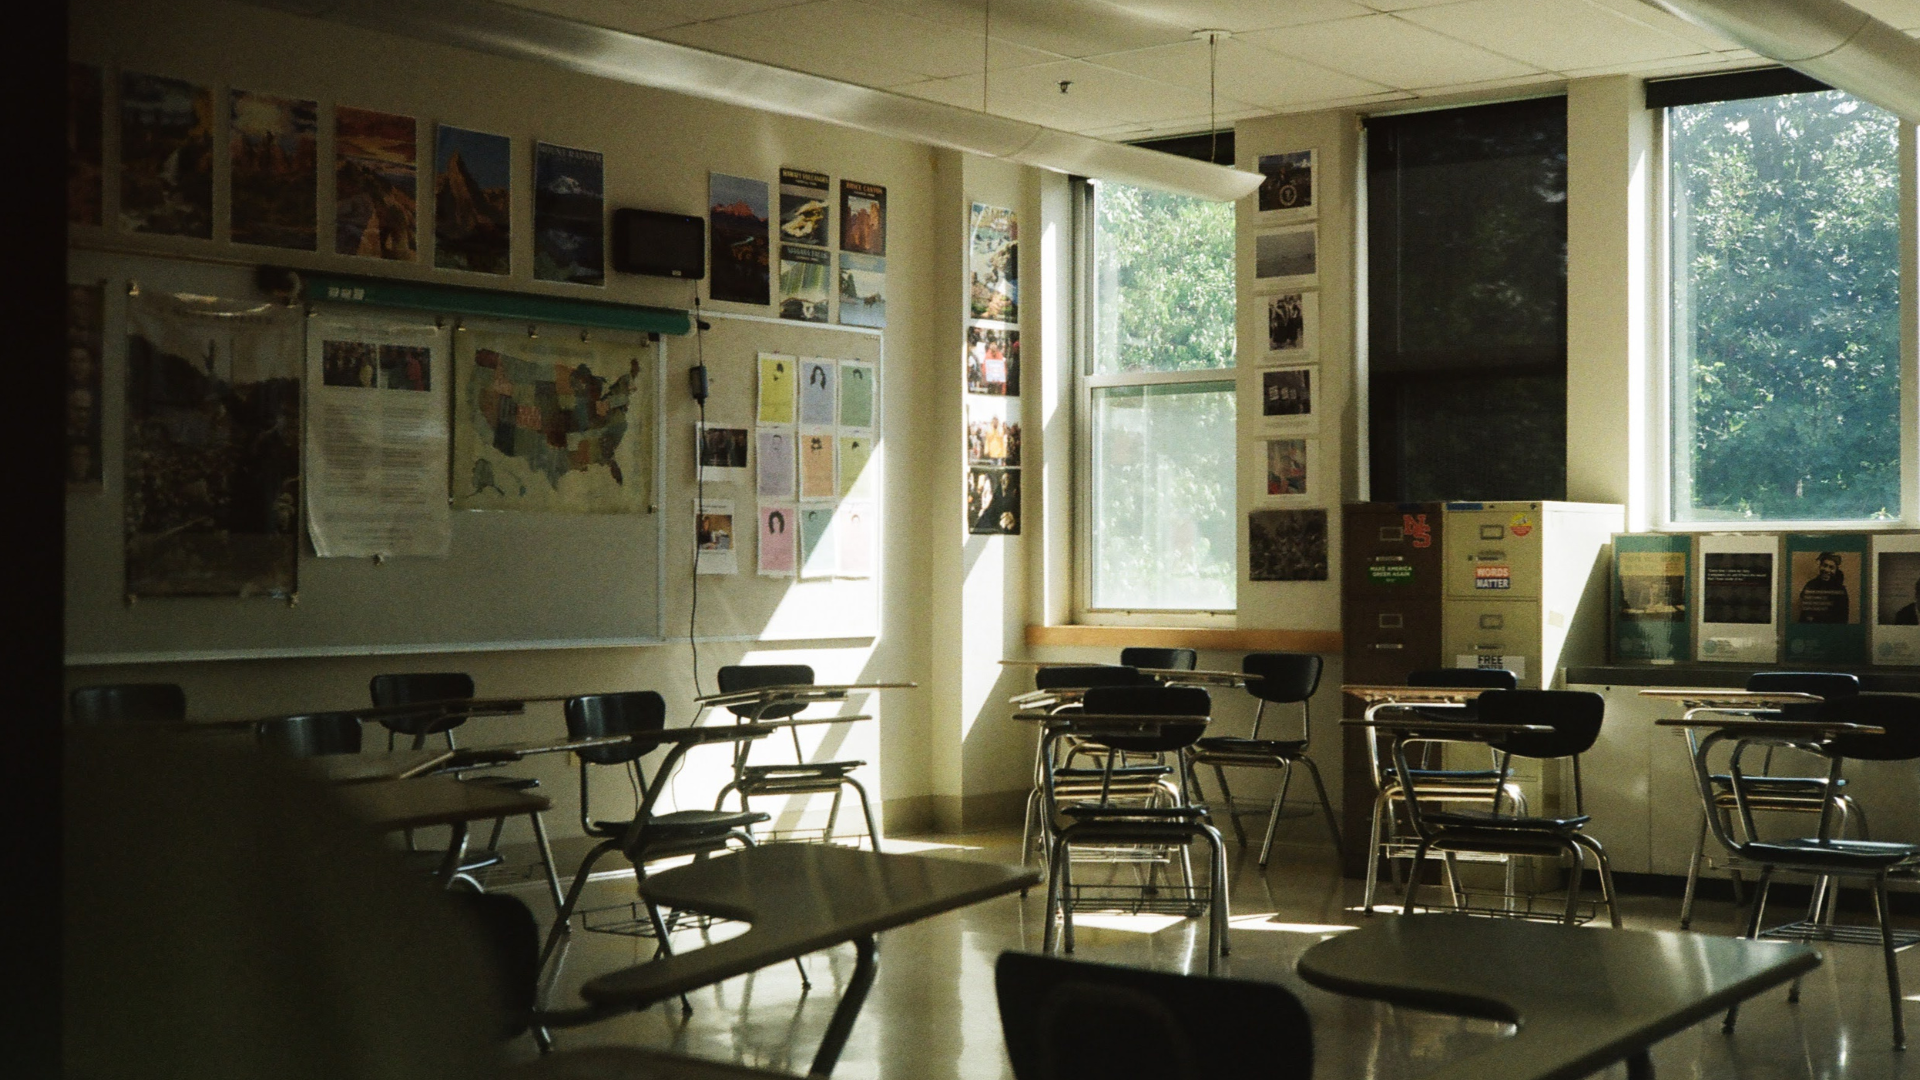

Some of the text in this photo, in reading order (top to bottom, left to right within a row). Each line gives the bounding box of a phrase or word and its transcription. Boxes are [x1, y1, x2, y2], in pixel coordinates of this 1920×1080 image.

[1476, 568, 1509, 577] WORDS
[1476, 578, 1509, 588] MATTER
[1478, 655, 1504, 665] FREE
